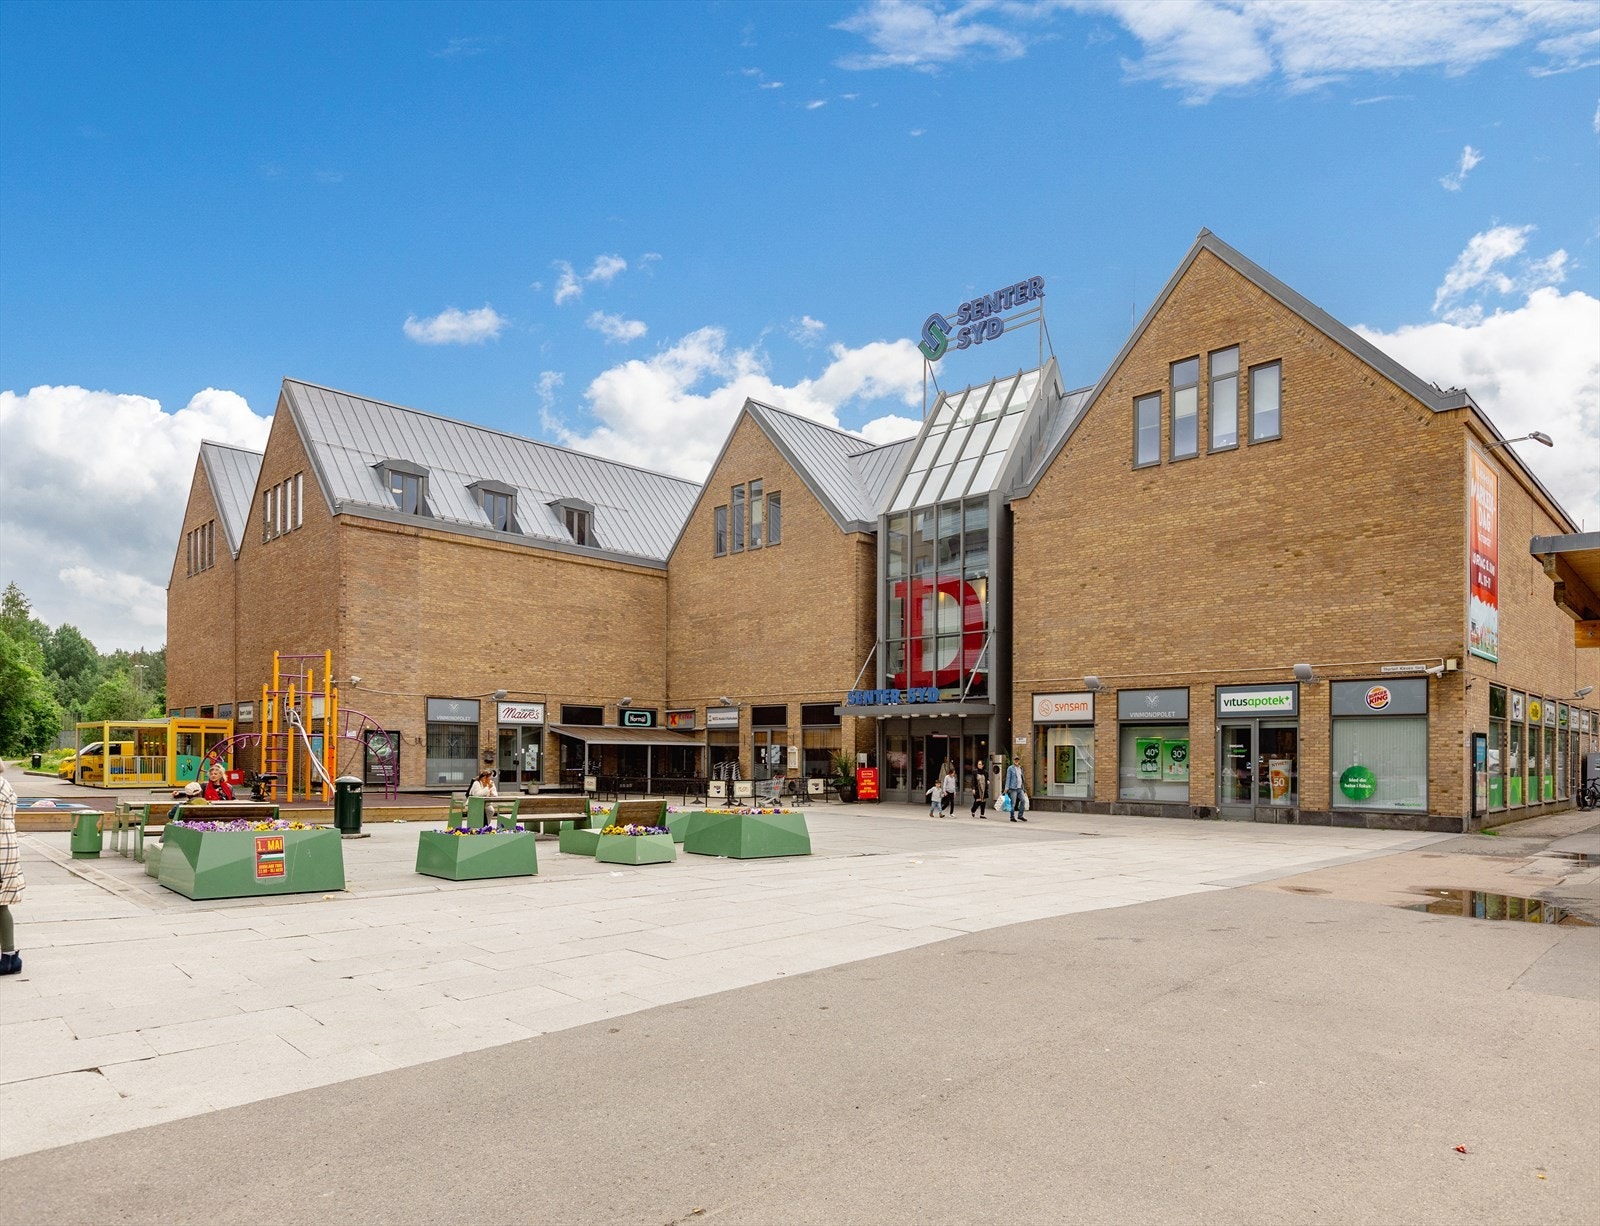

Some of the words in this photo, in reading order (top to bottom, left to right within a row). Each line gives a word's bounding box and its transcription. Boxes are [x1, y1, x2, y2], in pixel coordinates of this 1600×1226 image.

[957, 275, 1045, 326] SENTER
[957, 316, 1005, 350] SYD
[847, 688, 901, 706] SENTER
[907, 687, 940, 703] SYD
[1368, 689, 1388, 699] BURGER
[1368, 694, 1388, 705] KING
[1054, 702, 1089, 712] SYNSAM
[1223, 695, 1285, 708] vitusapotek
[629, 714, 647, 723] Normal
[1172, 750, 1186, 758] 30%
[1273, 777, 1285, 787] 50
[257, 840, 266, 851] 1.
[267, 839, 283, 851] MAI
